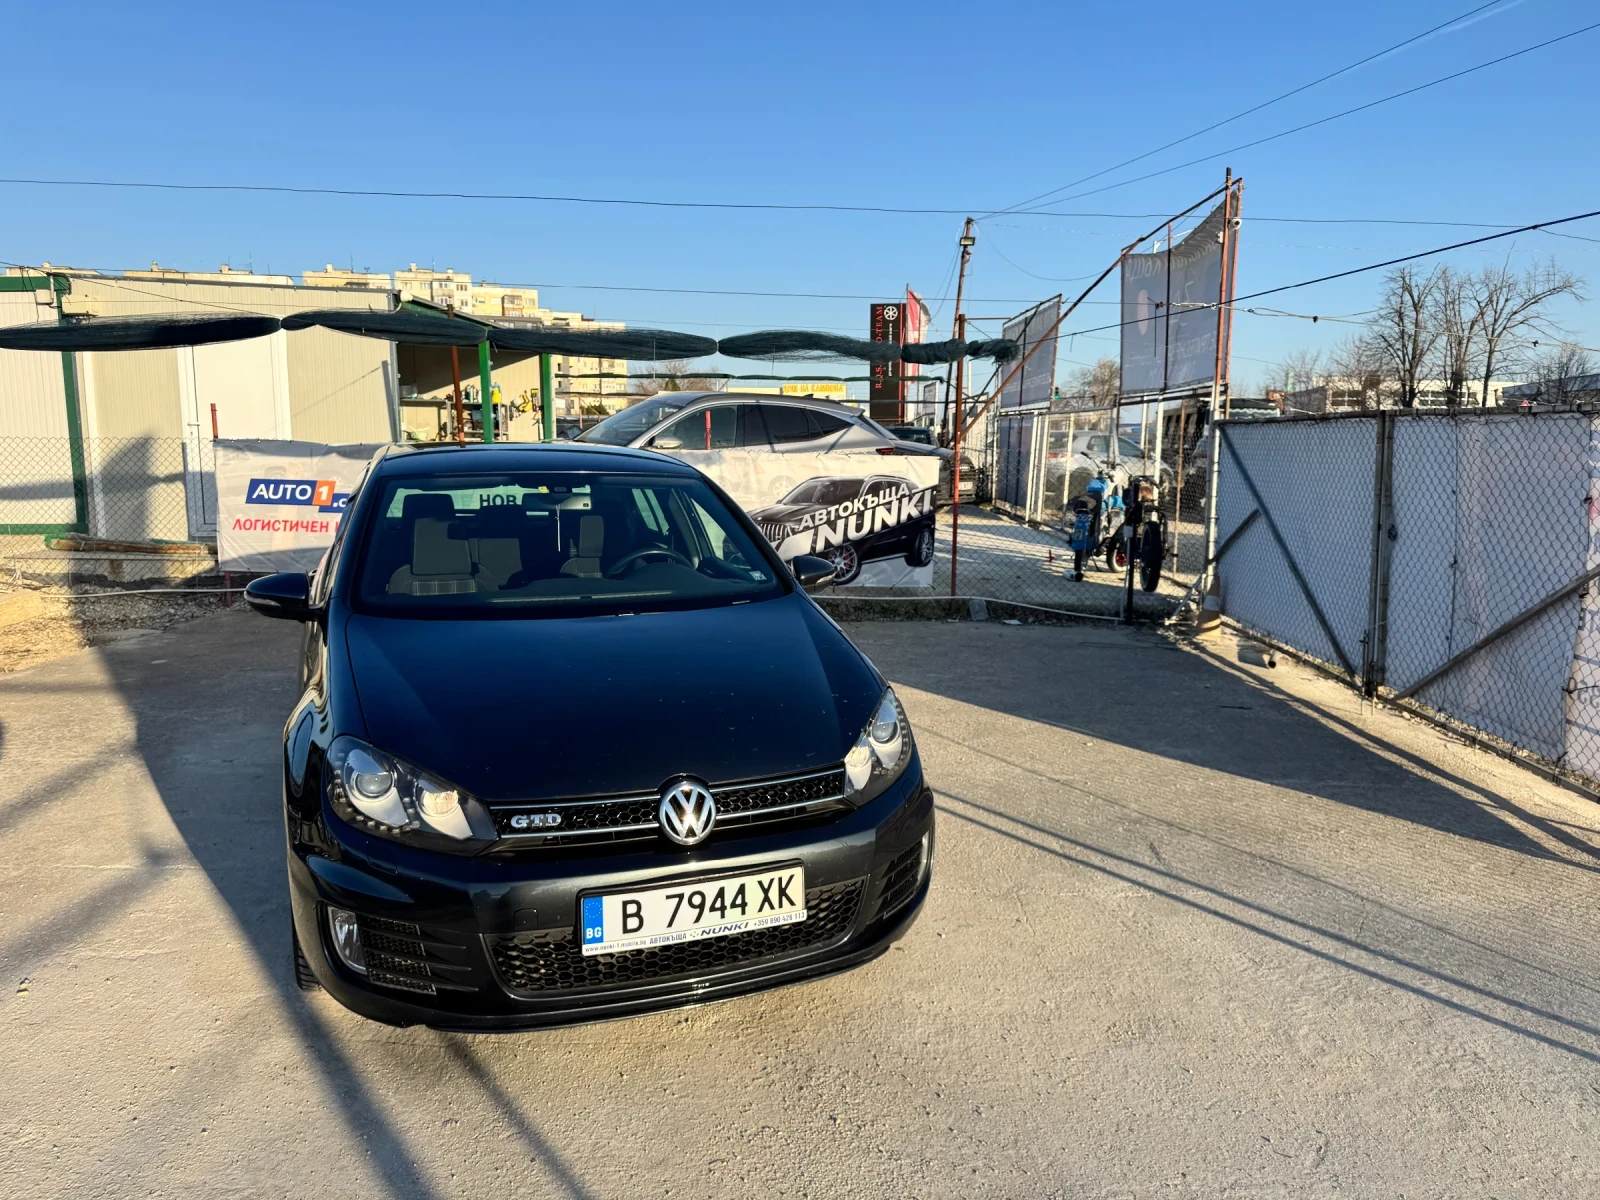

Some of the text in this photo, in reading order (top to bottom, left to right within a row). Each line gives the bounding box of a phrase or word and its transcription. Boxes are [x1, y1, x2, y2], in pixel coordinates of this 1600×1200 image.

[799, 483, 910, 531] АВТОКЪЩА
[816, 489, 932, 554] NUNKI
[232, 518, 329, 533] ЛОГИСТИЧЕН
[510, 813, 562, 829] GTD
[665, 882, 748, 928] 7944
[585, 927, 602, 939] BG
[649, 932, 687, 945] АВТОКЪЩА
[700, 921, 749, 937] NUNKI
[794, 911, 805, 920] 113
